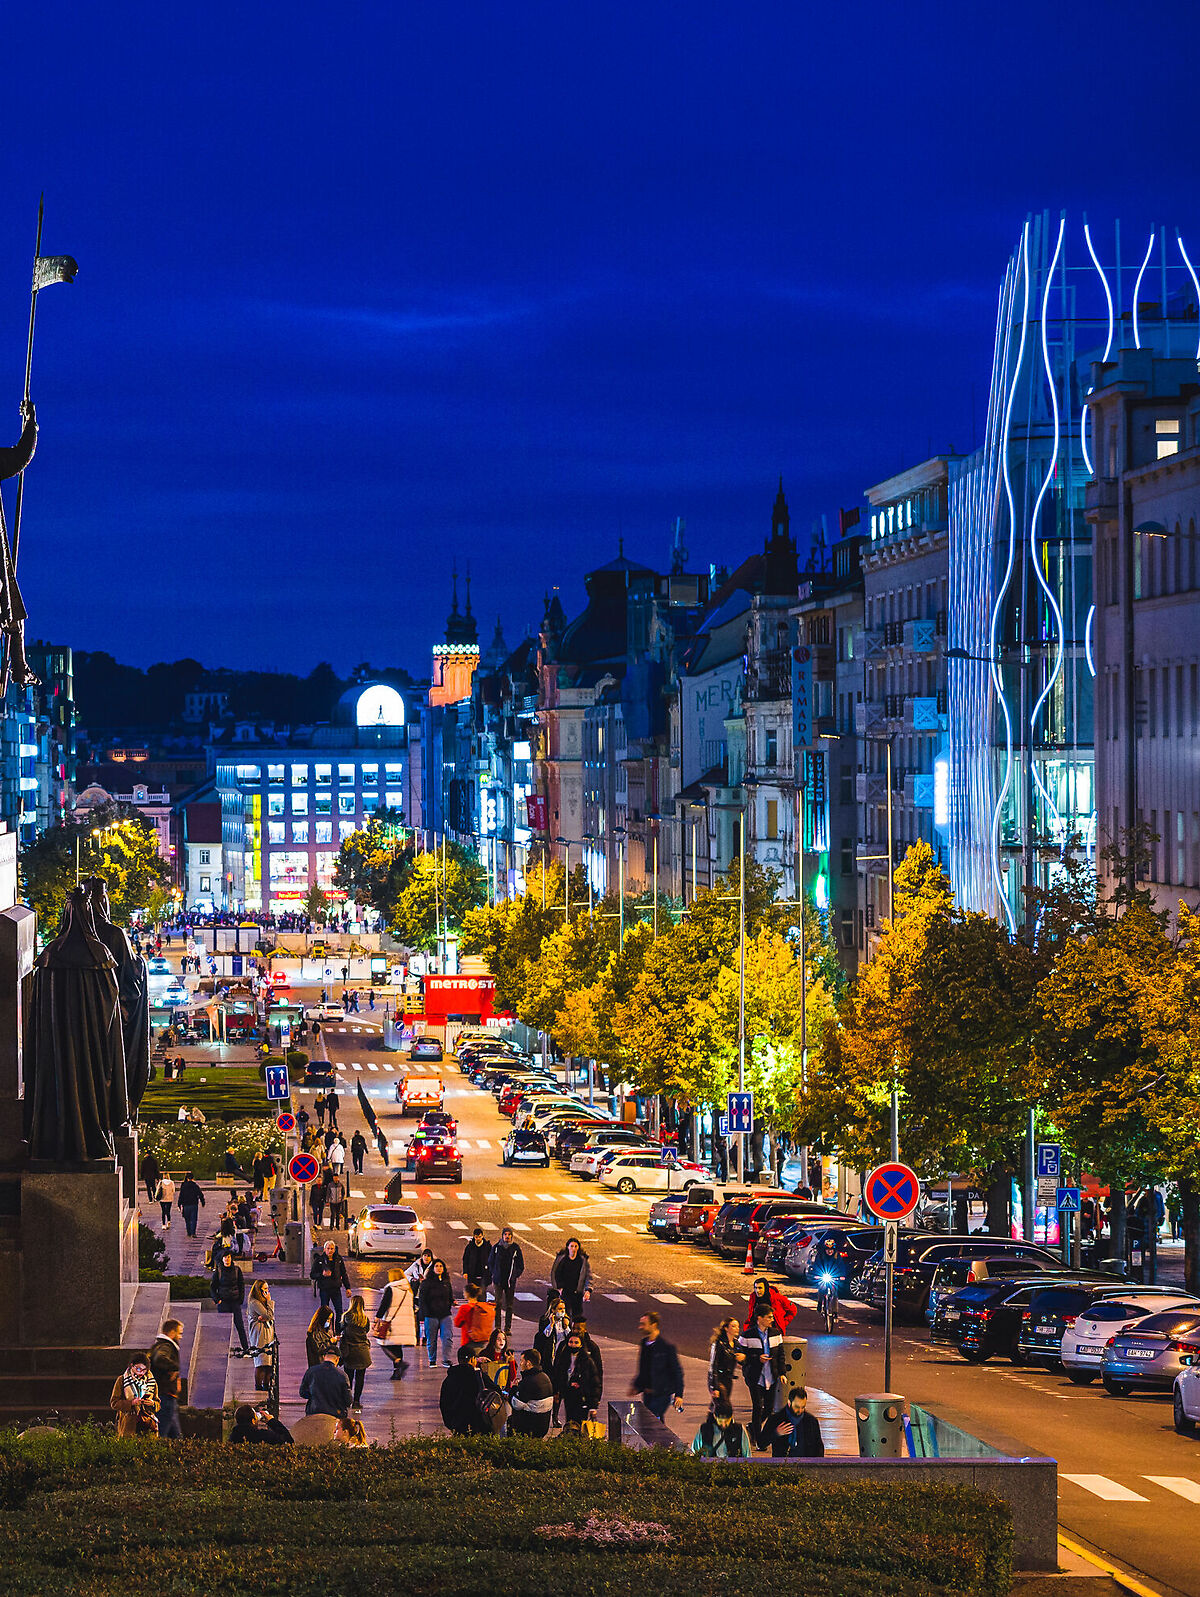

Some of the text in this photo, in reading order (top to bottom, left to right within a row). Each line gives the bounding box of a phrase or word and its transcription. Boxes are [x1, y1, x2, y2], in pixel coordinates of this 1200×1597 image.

[871, 501, 912, 541] HOTEL
[797, 671, 808, 745] RAMADA
[1043, 1149, 1055, 1166] P
